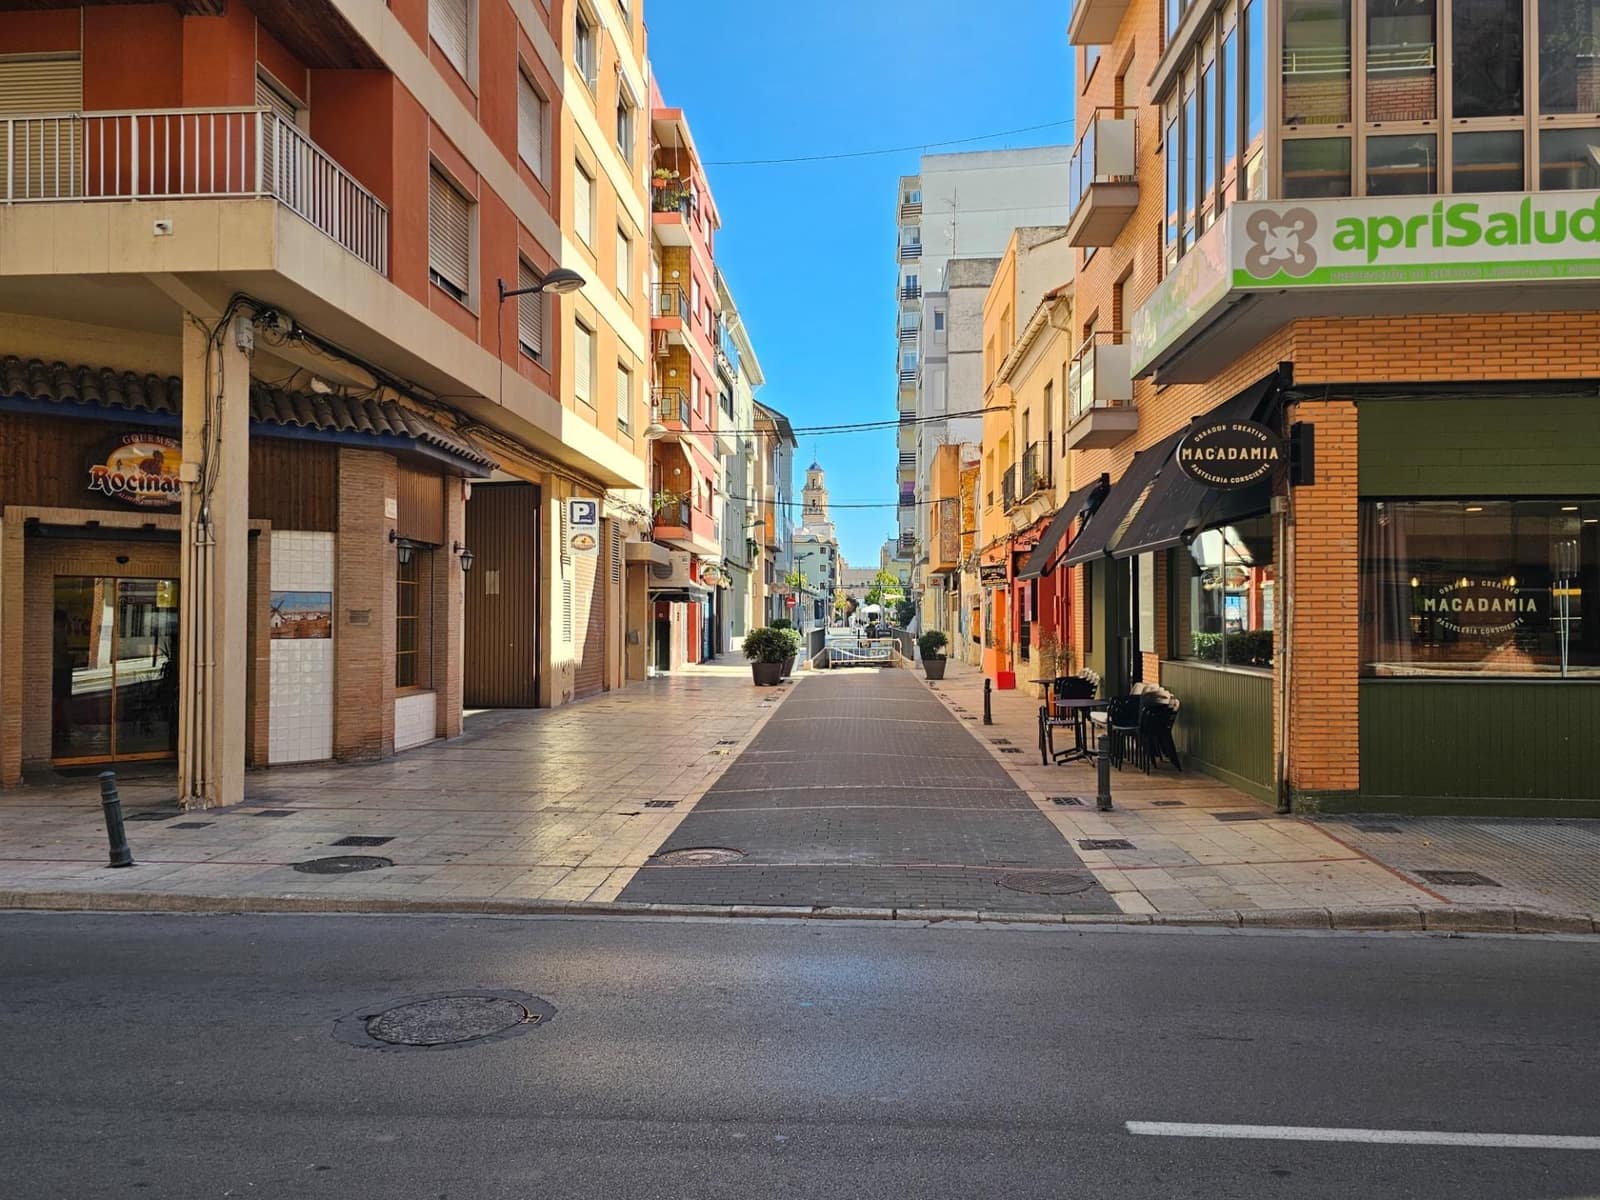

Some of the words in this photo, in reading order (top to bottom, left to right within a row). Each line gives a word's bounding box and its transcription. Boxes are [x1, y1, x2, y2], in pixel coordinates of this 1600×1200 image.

[1333, 195, 1600, 264] apriSalud
[1194, 424, 1227, 442] OBRADOR
[1232, 424, 1268, 441] CREATIVO
[1182, 447, 1279, 460] MACADAMIA
[1230, 463, 1270, 484] CONSCIENTE
[572, 503, 590, 523] P
[1481, 580, 1520, 594] CREATIVO
[1424, 598, 1537, 612] MACADAMIA
[1480, 617, 1524, 635] CONSCIENTE
